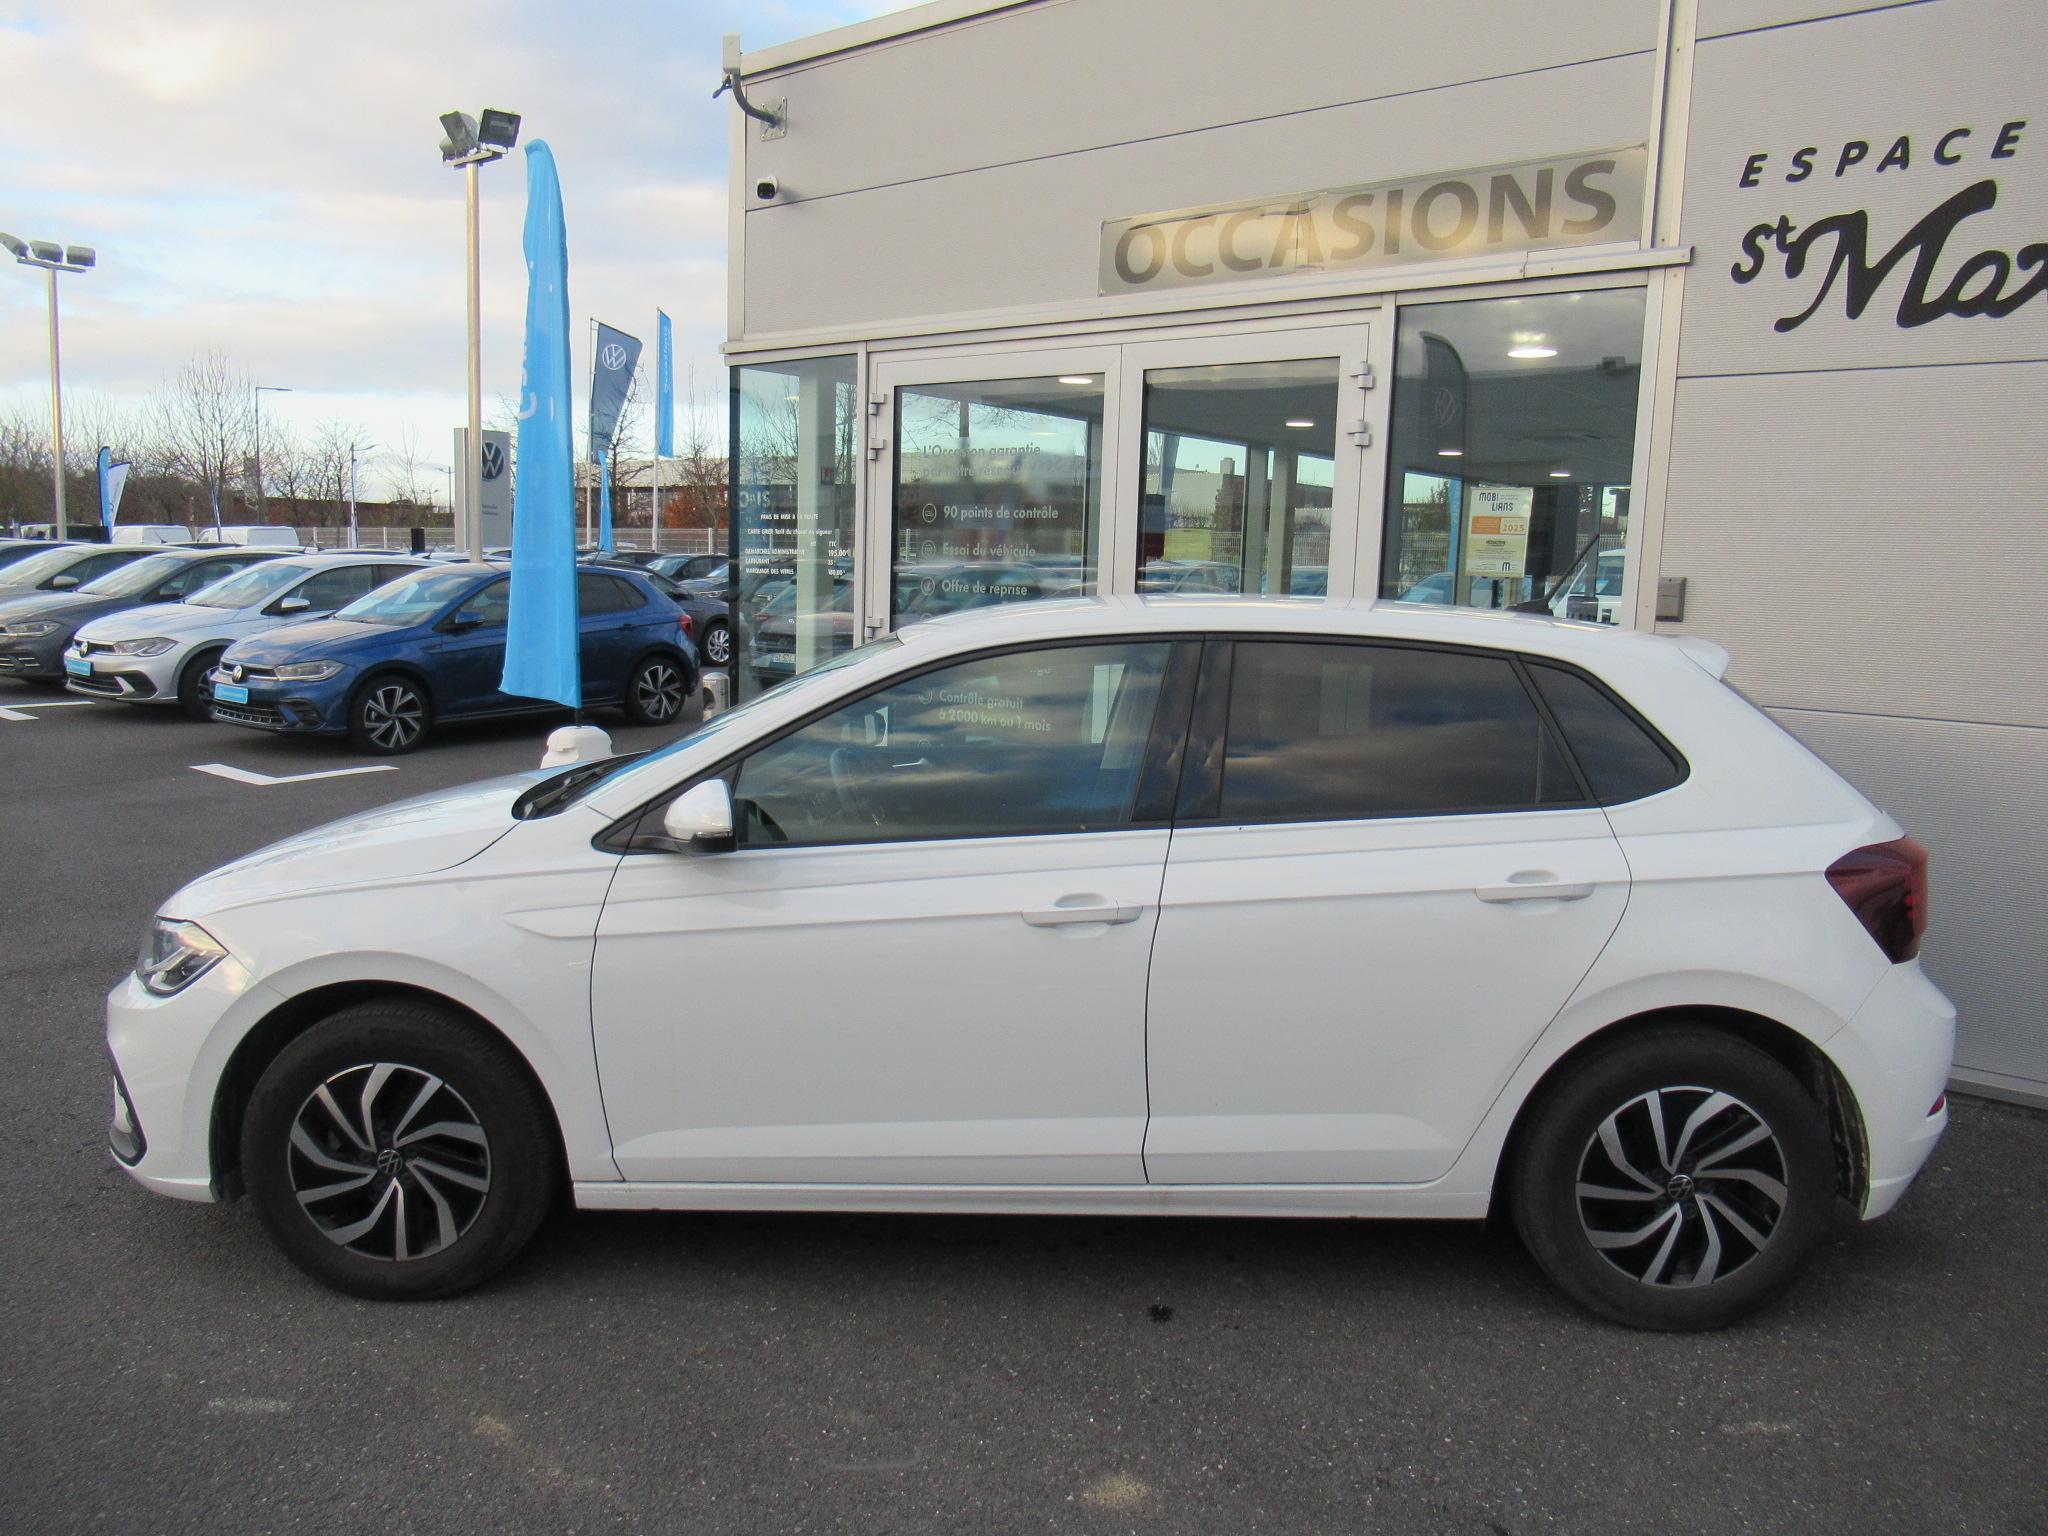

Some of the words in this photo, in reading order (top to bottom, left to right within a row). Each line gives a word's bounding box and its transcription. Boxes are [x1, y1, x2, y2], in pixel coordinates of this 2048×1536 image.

[1739, 121, 2027, 188] ESPACE
[1114, 159, 1617, 285] OCCASIONS
[1731, 215, 1797, 285] St
[943, 505, 958, 519] 90
[960, 505, 993, 521] points
[996, 505, 1010, 519] de
[1013, 504, 1059, 520] contrôle
[942, 542, 970, 556] Essai
[972, 542, 986, 556] du
[990, 543, 1036, 558] véhicule
[941, 579, 970, 593] Offre
[972, 580, 986, 594] de
[989, 582, 1028, 599] reprise
[940, 689, 984, 705] Contrôle
[948, 708, 978, 724] 2000
